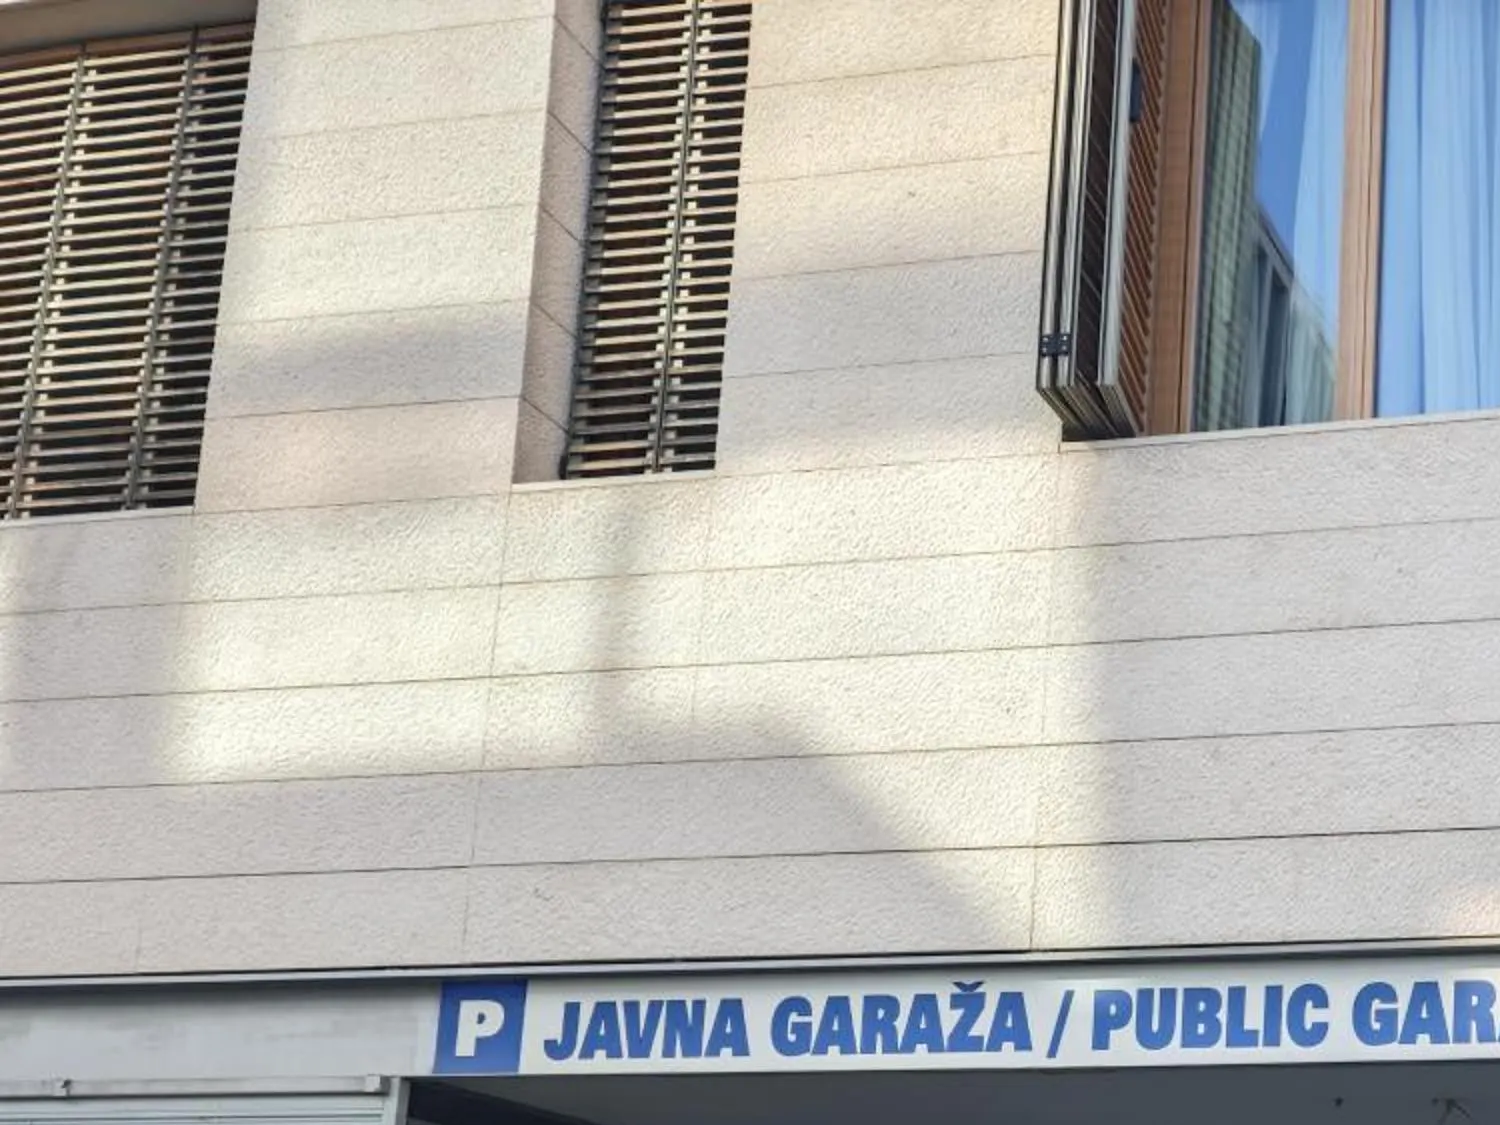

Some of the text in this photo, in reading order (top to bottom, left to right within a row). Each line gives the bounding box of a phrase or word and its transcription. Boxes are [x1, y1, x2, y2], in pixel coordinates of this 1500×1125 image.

[455, 1000, 504, 1057] P
[544, 999, 749, 1060] JAVNA
[770, 982, 1032, 1056] GARAŽA
[1091, 983, 1329, 1051] PUBLIC
